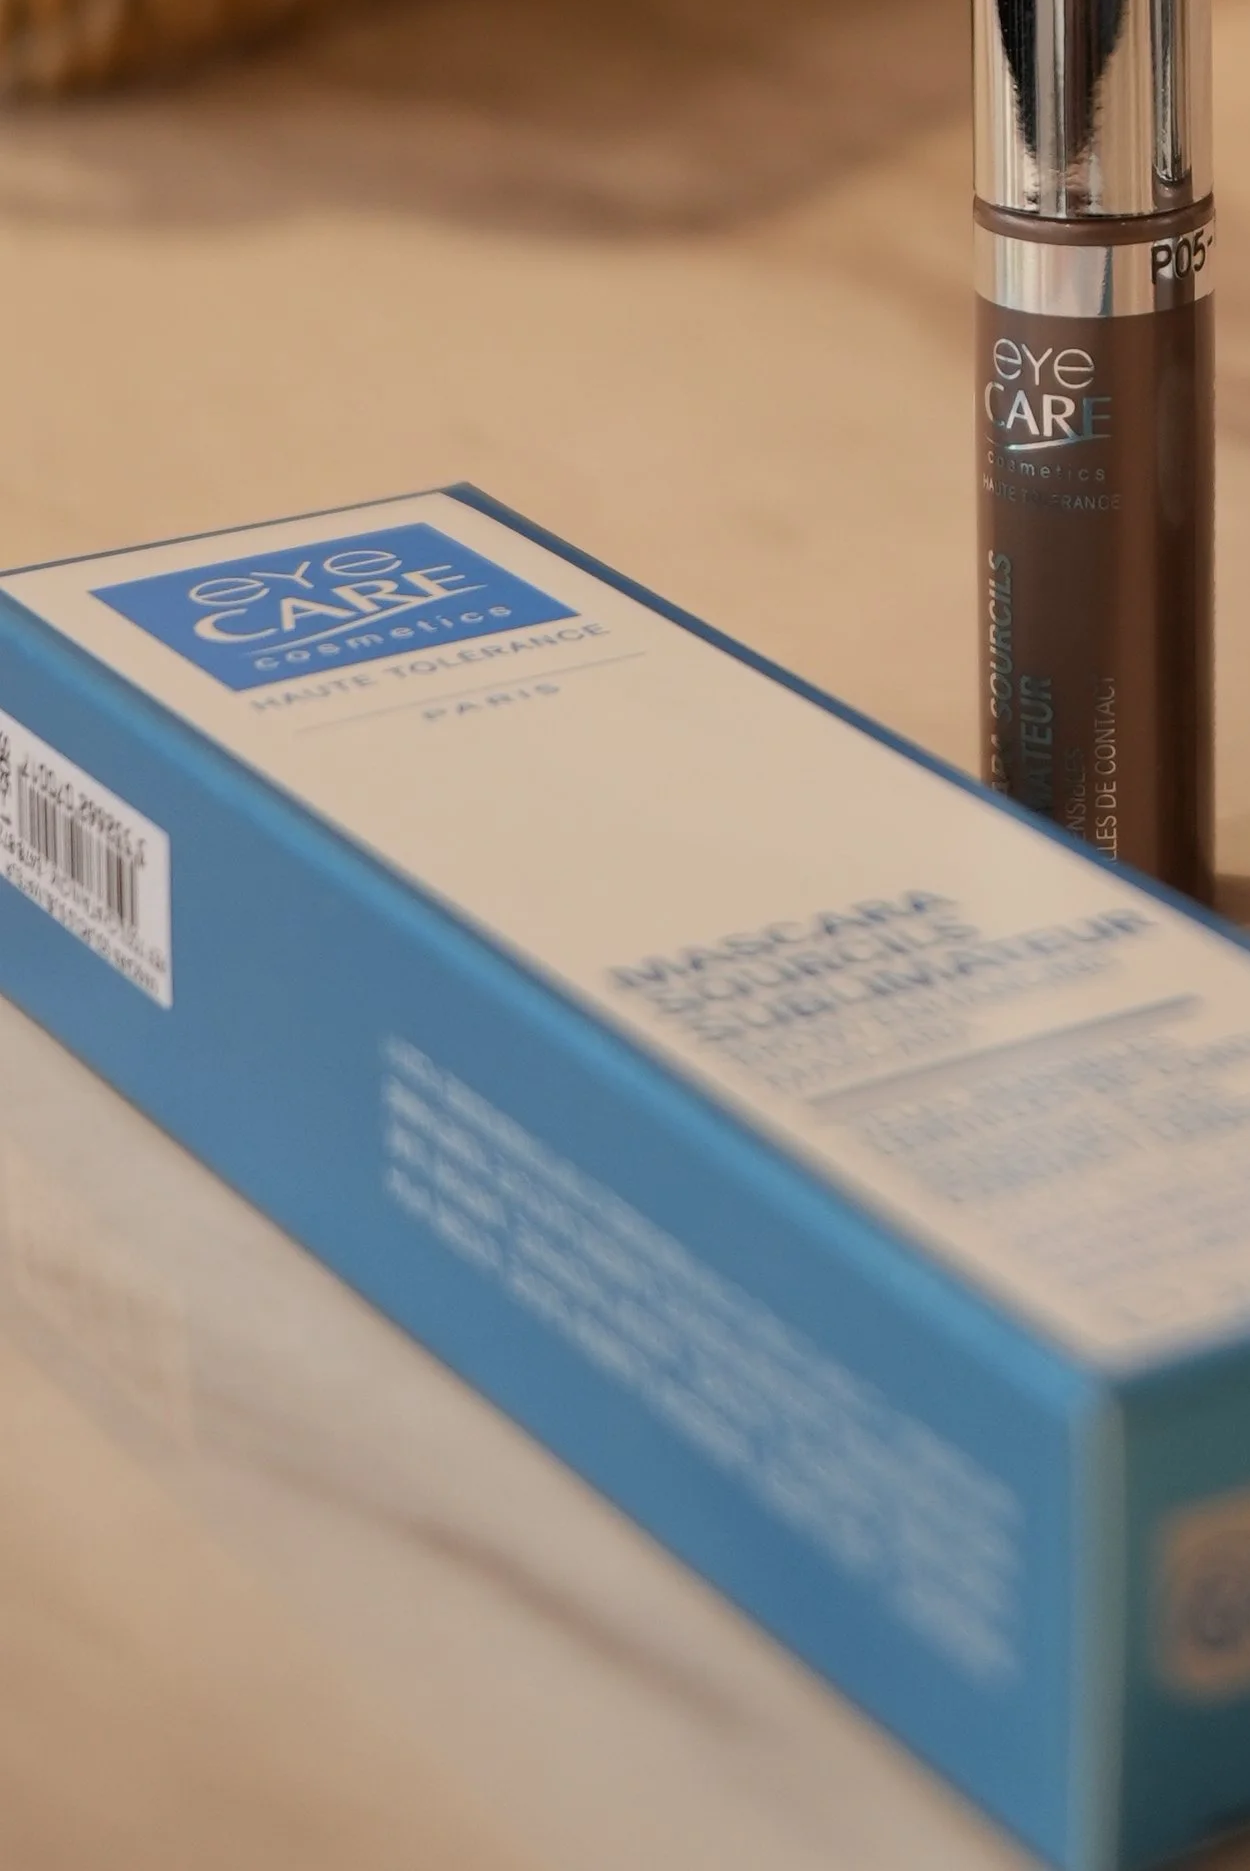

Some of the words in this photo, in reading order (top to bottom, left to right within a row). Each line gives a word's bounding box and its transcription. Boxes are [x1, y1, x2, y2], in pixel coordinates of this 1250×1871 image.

[992, 337, 1095, 389] eye
[984, 380, 1113, 439] CARE
[188, 548, 403, 608] eye
[193, 563, 468, 644] CARE
[252, 604, 512, 672] cosmetics
[987, 549, 1013, 724] SOURCILS
[250, 673, 379, 714] HAUTE
[421, 681, 562, 722] PARIS
[1094, 675, 1117, 776] CONTACT
[1095, 780, 1117, 809] DE
